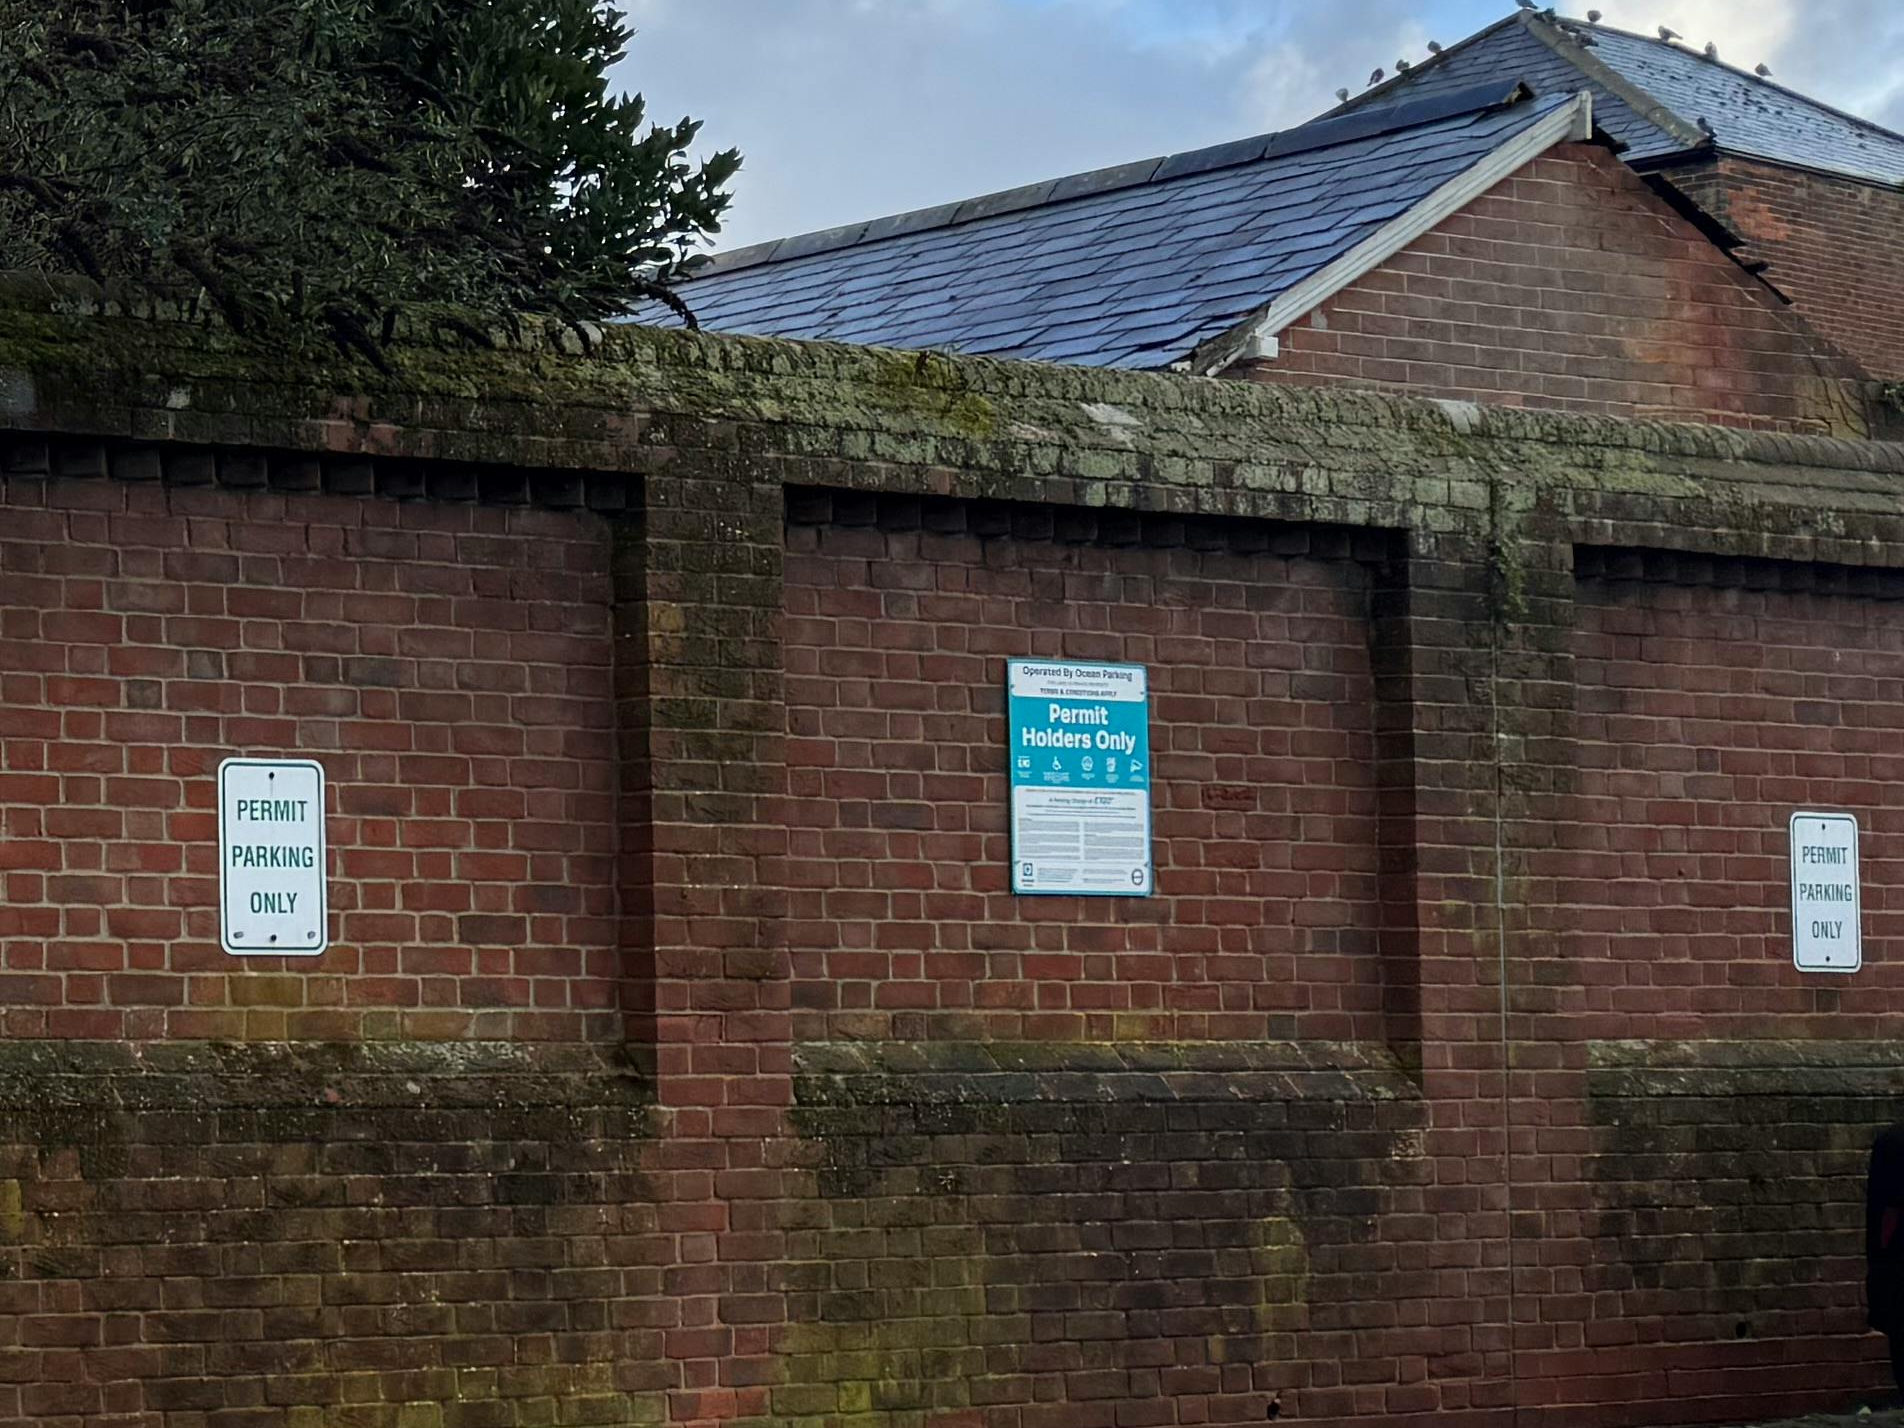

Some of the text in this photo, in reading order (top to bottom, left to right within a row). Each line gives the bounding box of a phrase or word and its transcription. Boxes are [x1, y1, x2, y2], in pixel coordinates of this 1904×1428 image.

[1022, 666, 1133, 682] Operated By Ocean Parking
[1049, 703, 1109, 725] Permit
[1022, 726, 1136, 755] Holders Only
[237, 799, 308, 822] PERMIT
[232, 845, 313, 868] PARKING
[1802, 845, 1848, 864] PERMIT
[250, 892, 298, 914] ONLY
[1799, 883, 1852, 902] PARKING
[1812, 920, 1842, 939] ONLY
